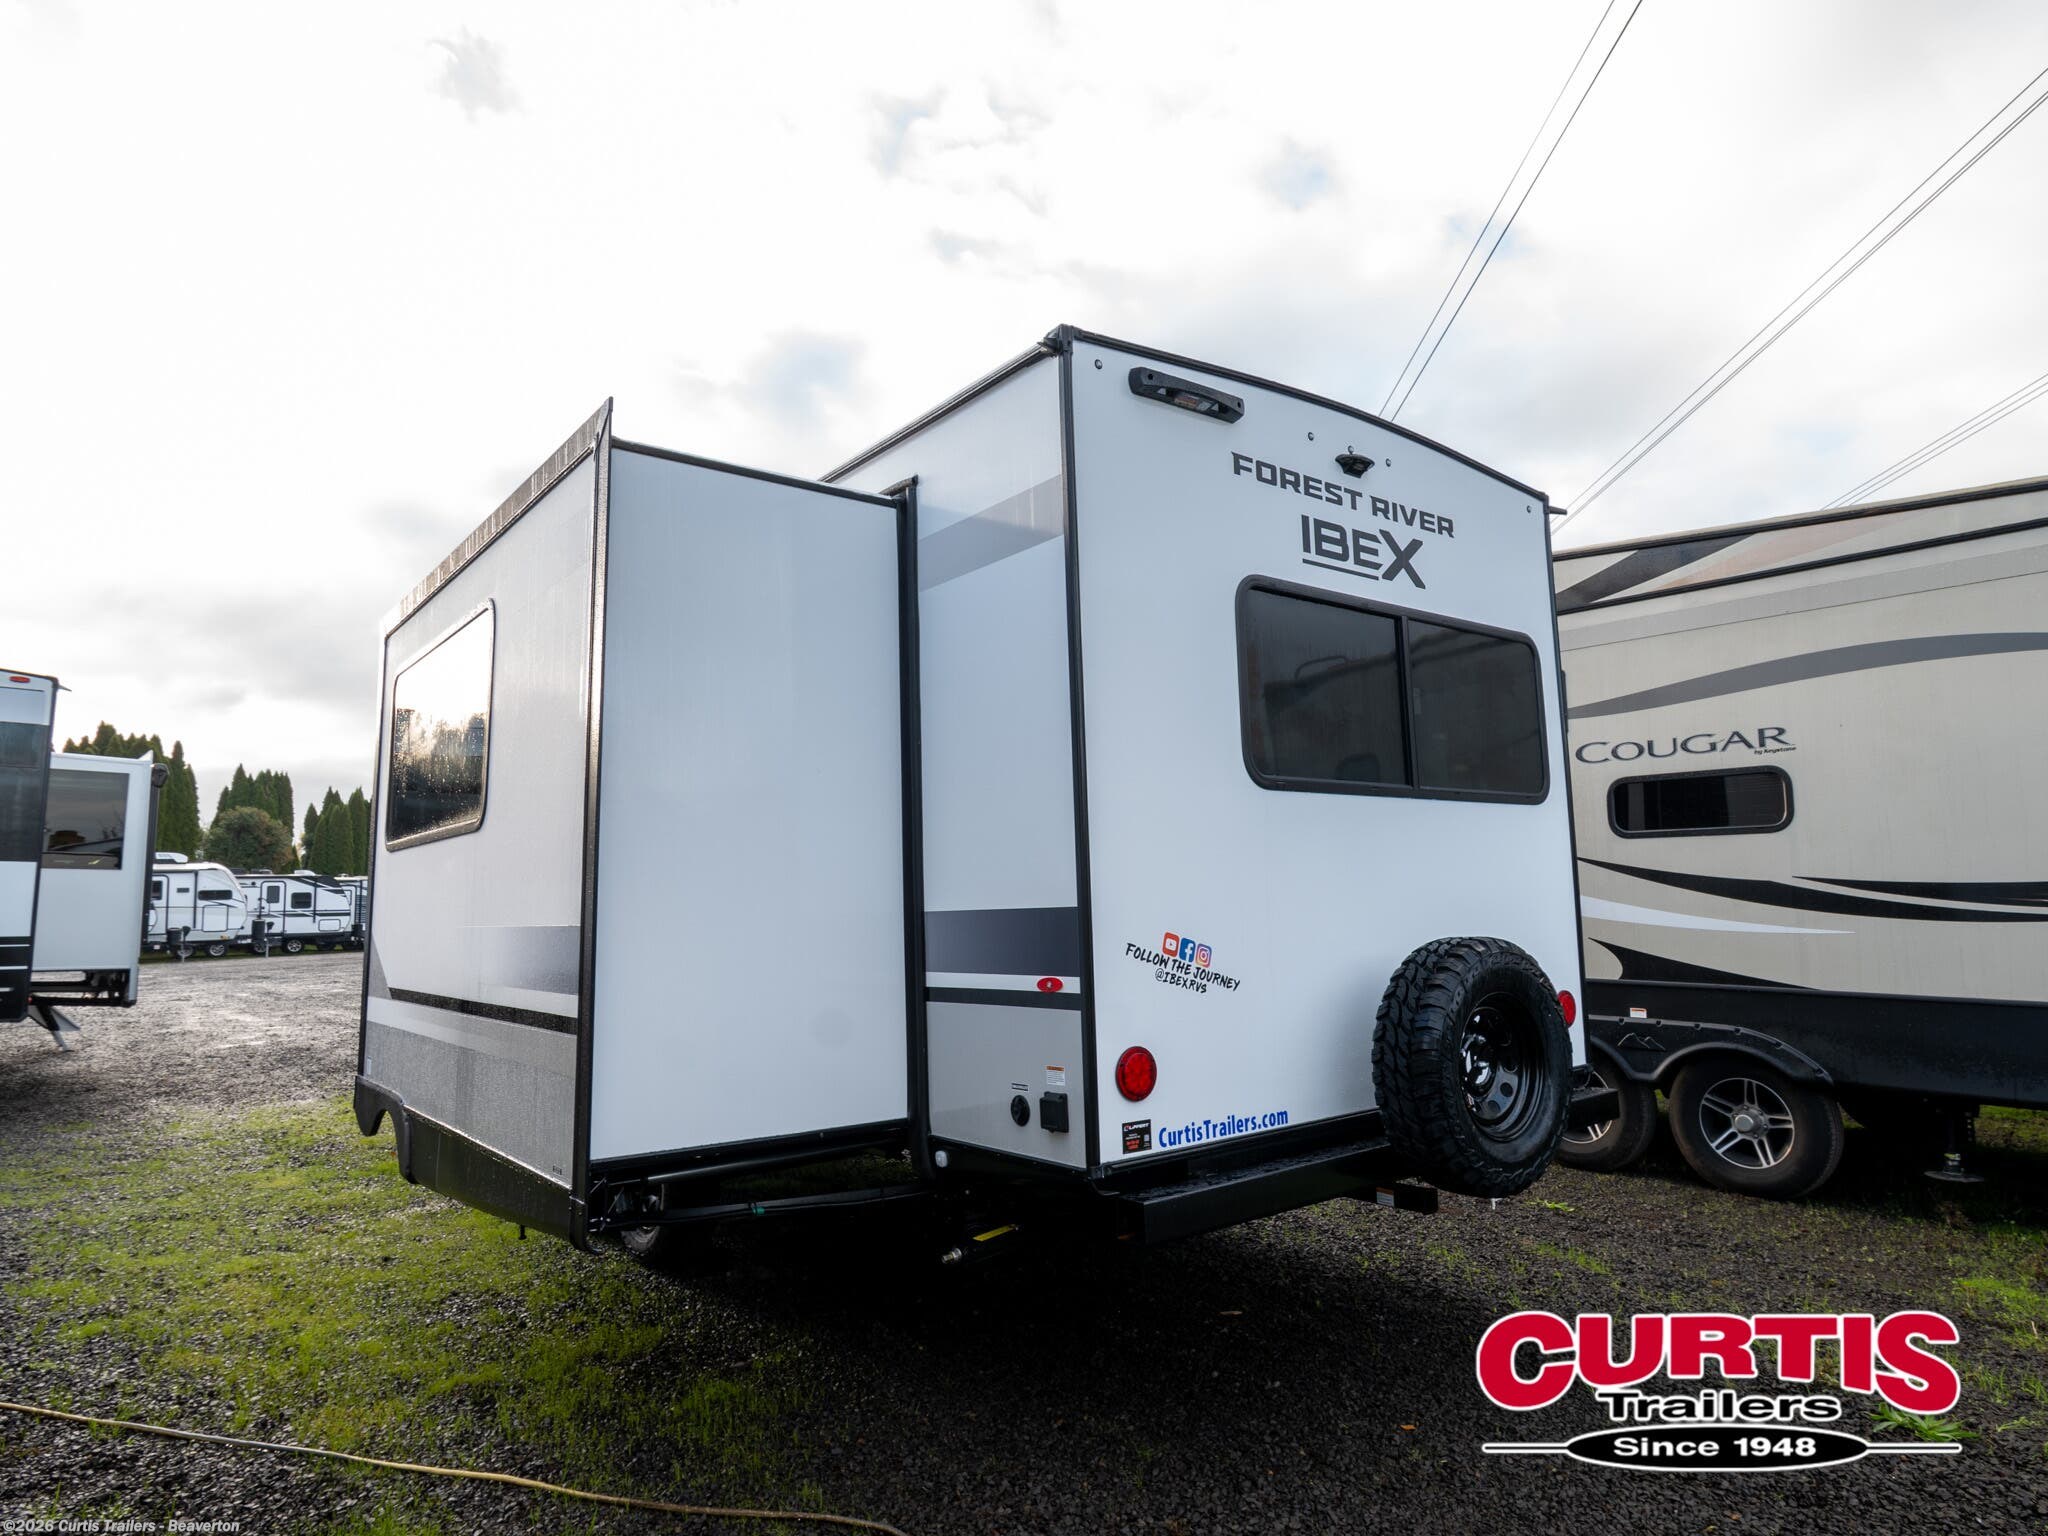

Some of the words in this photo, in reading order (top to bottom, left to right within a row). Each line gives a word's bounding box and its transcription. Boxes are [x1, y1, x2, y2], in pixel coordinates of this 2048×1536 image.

[1231, 451, 1363, 511] FOREST
[1370, 495, 1455, 538] RIVER
[1301, 514, 1426, 589] IBEX
[1575, 726, 1790, 763] COUGAR
[1125, 942, 1170, 969] FOLLOW
[1171, 958, 1192, 975] THE
[1193, 966, 1241, 991] JOURNEY
[1154, 967, 1207, 993] @IBEXRVS
[1158, 1109, 1289, 1148] CurtisTrailers.com
